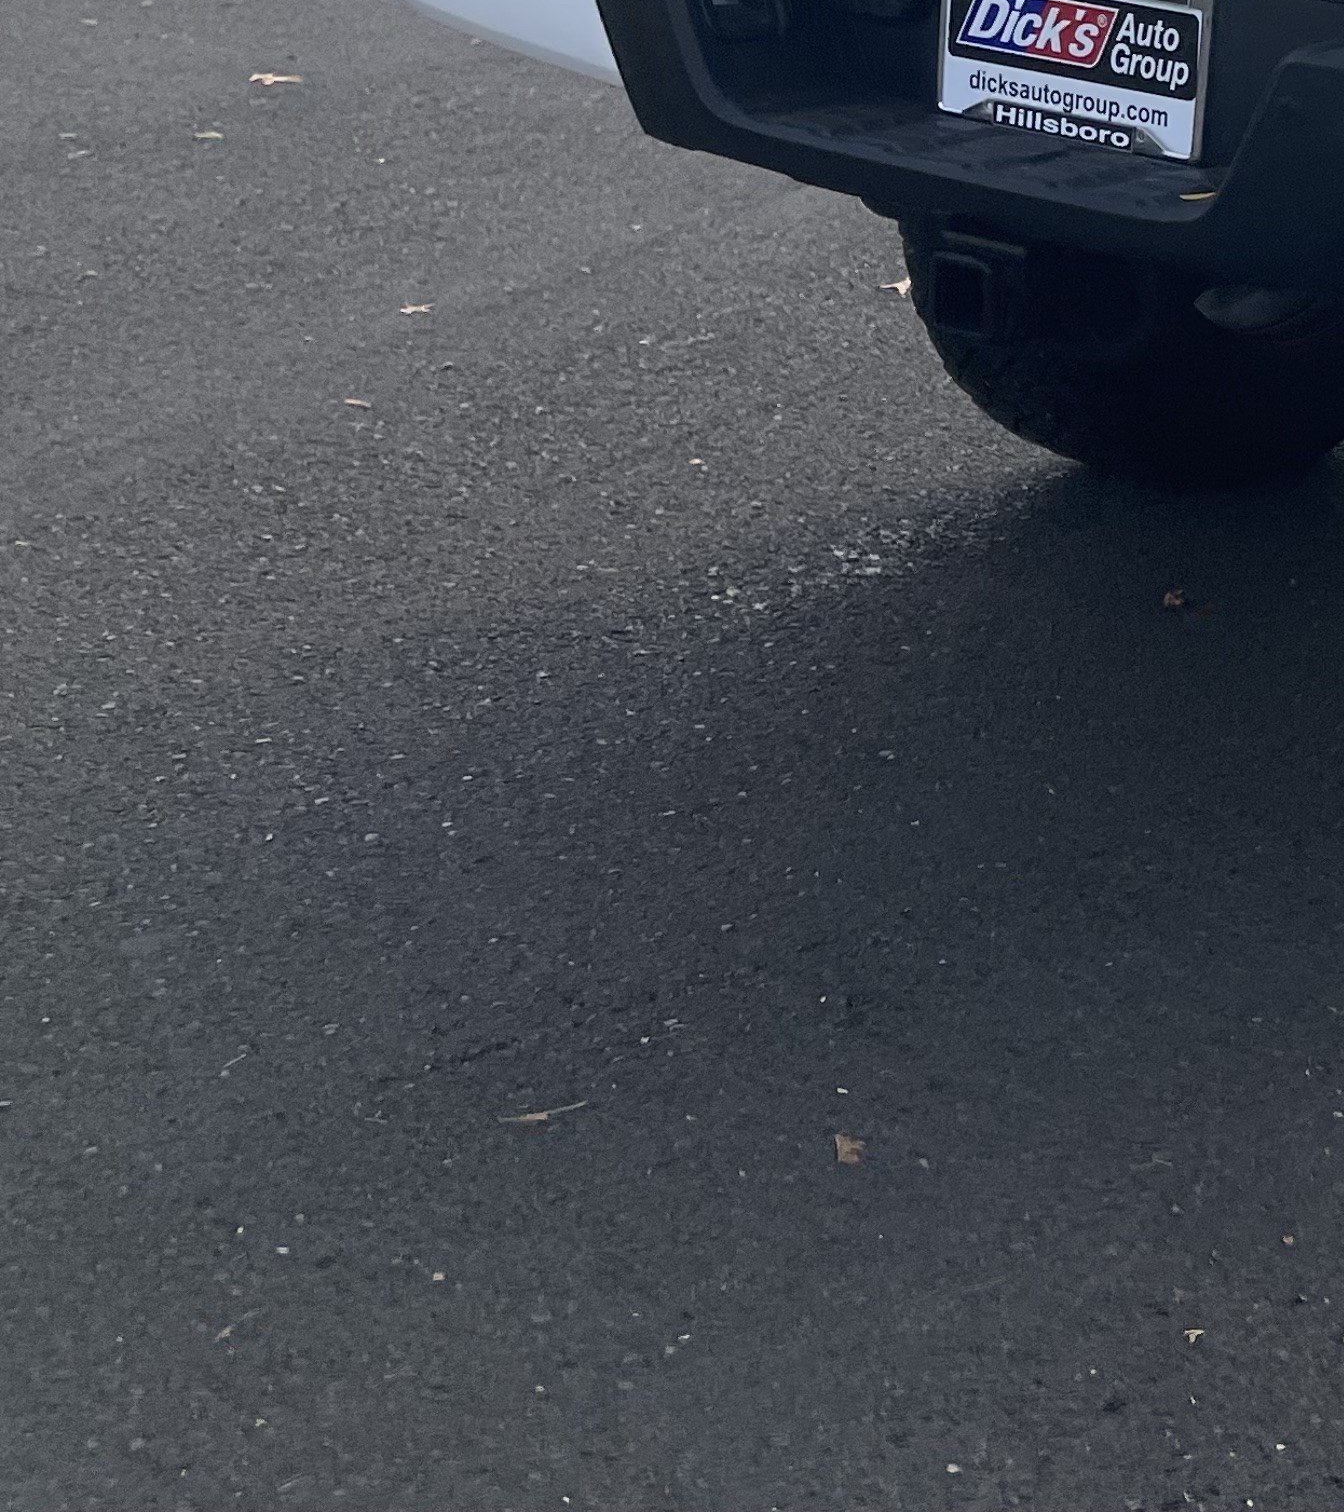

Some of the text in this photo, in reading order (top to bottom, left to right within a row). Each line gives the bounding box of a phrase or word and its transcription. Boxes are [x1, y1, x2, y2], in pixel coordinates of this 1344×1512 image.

[1116, 12, 1180, 52] Auto
[1110, 43, 1190, 91] Group
[968, 69, 1168, 128] dicksautogroup.com
[995, 104, 1130, 148] Hillsboro
